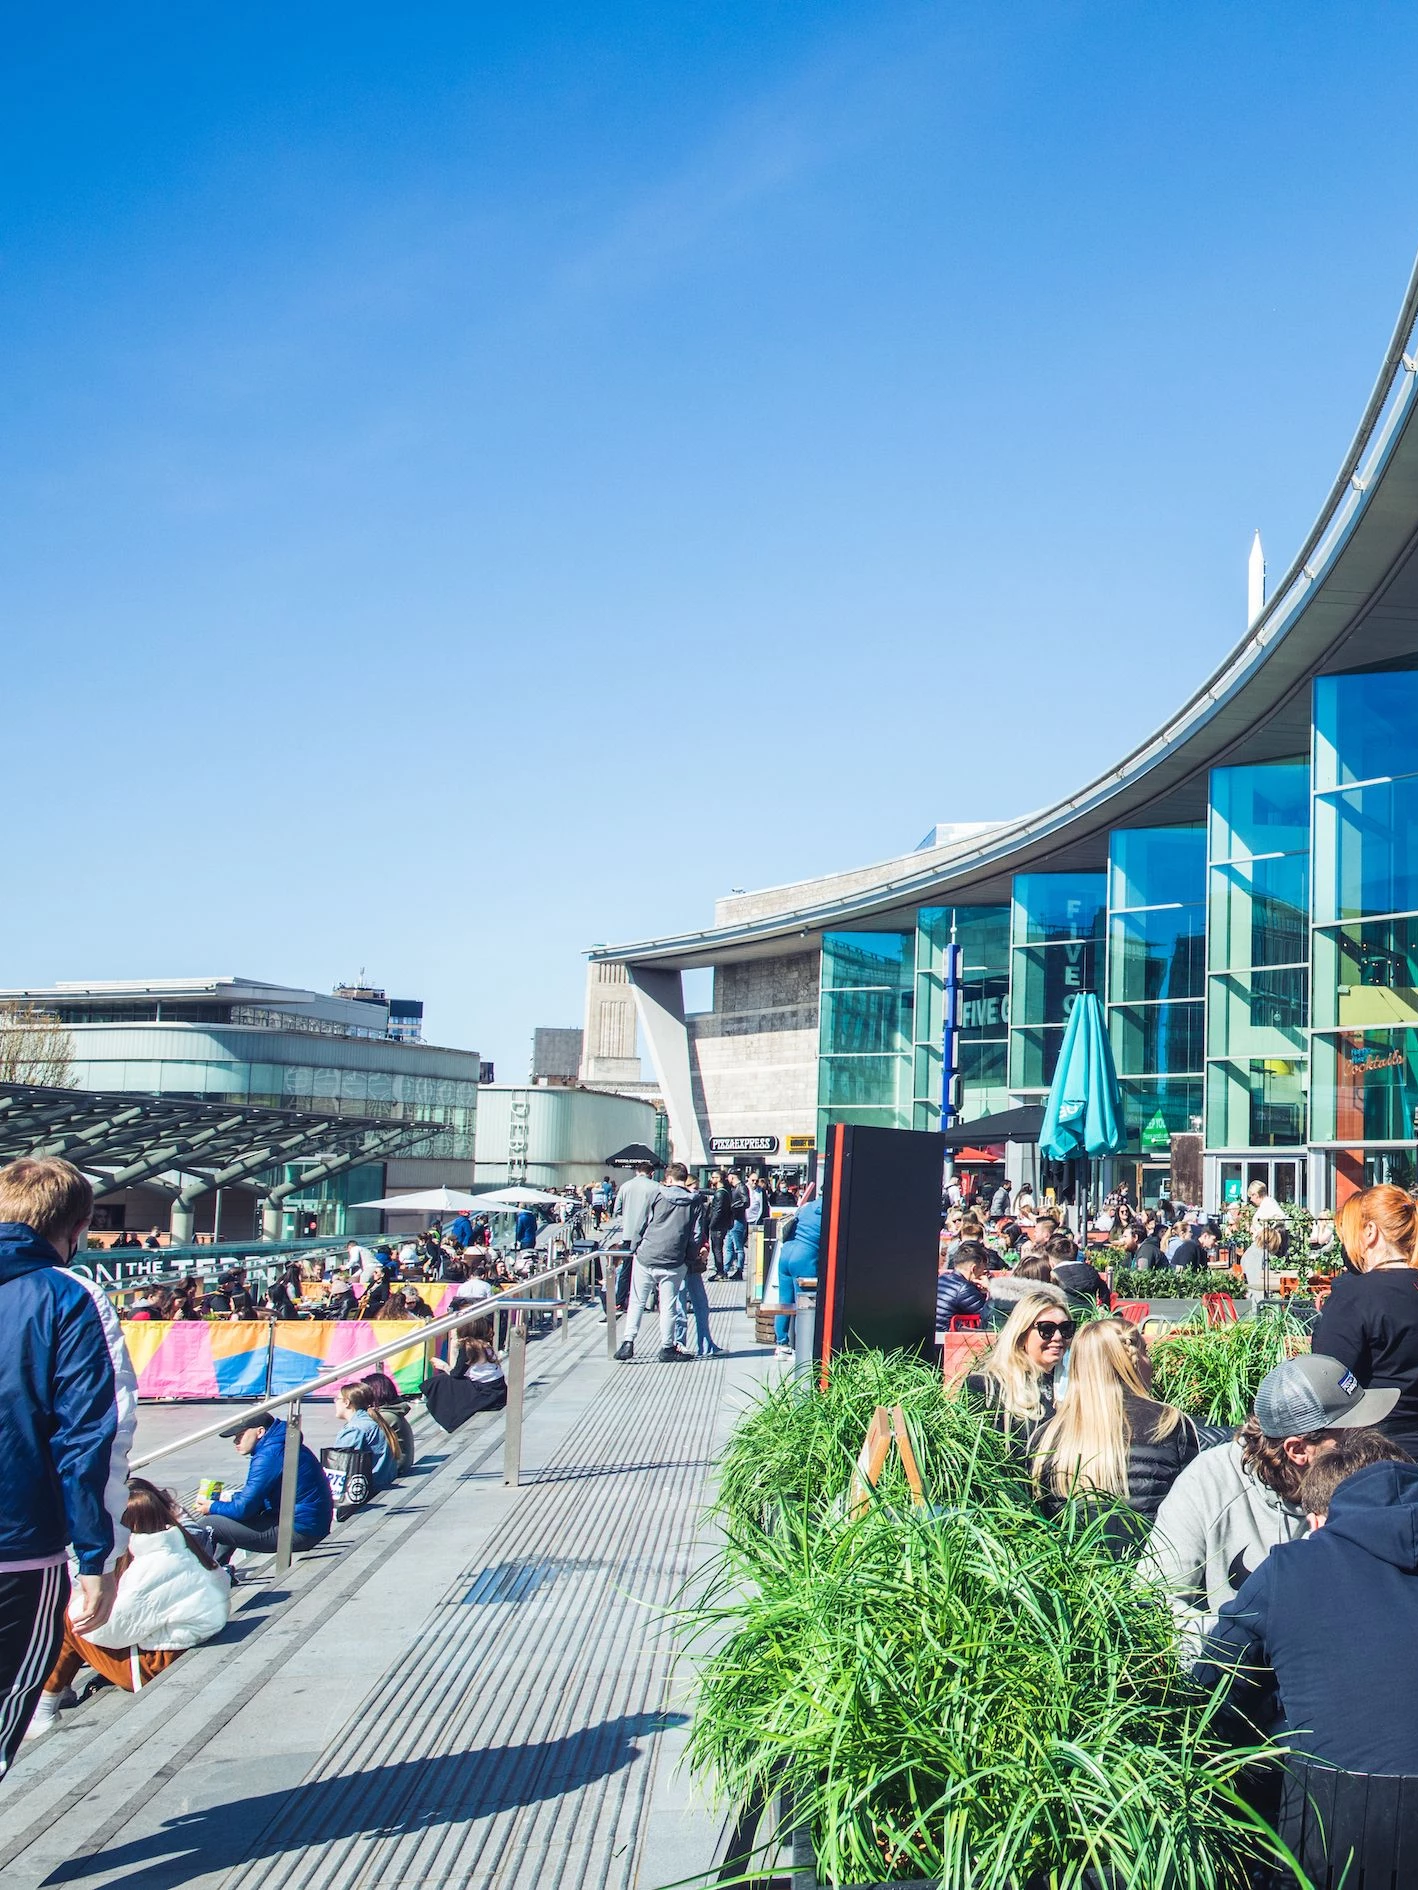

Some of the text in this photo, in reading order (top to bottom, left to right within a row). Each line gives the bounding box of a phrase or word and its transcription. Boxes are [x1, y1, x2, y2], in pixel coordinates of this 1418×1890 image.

[1065, 900, 1082, 986] FIVE
[962, 997, 1000, 1029] FIVE
[1343, 1049, 1405, 1077] Cocktails
[712, 1138, 771, 1150] PIZZAEXPRESS
[125, 1261, 164, 1276] THE
